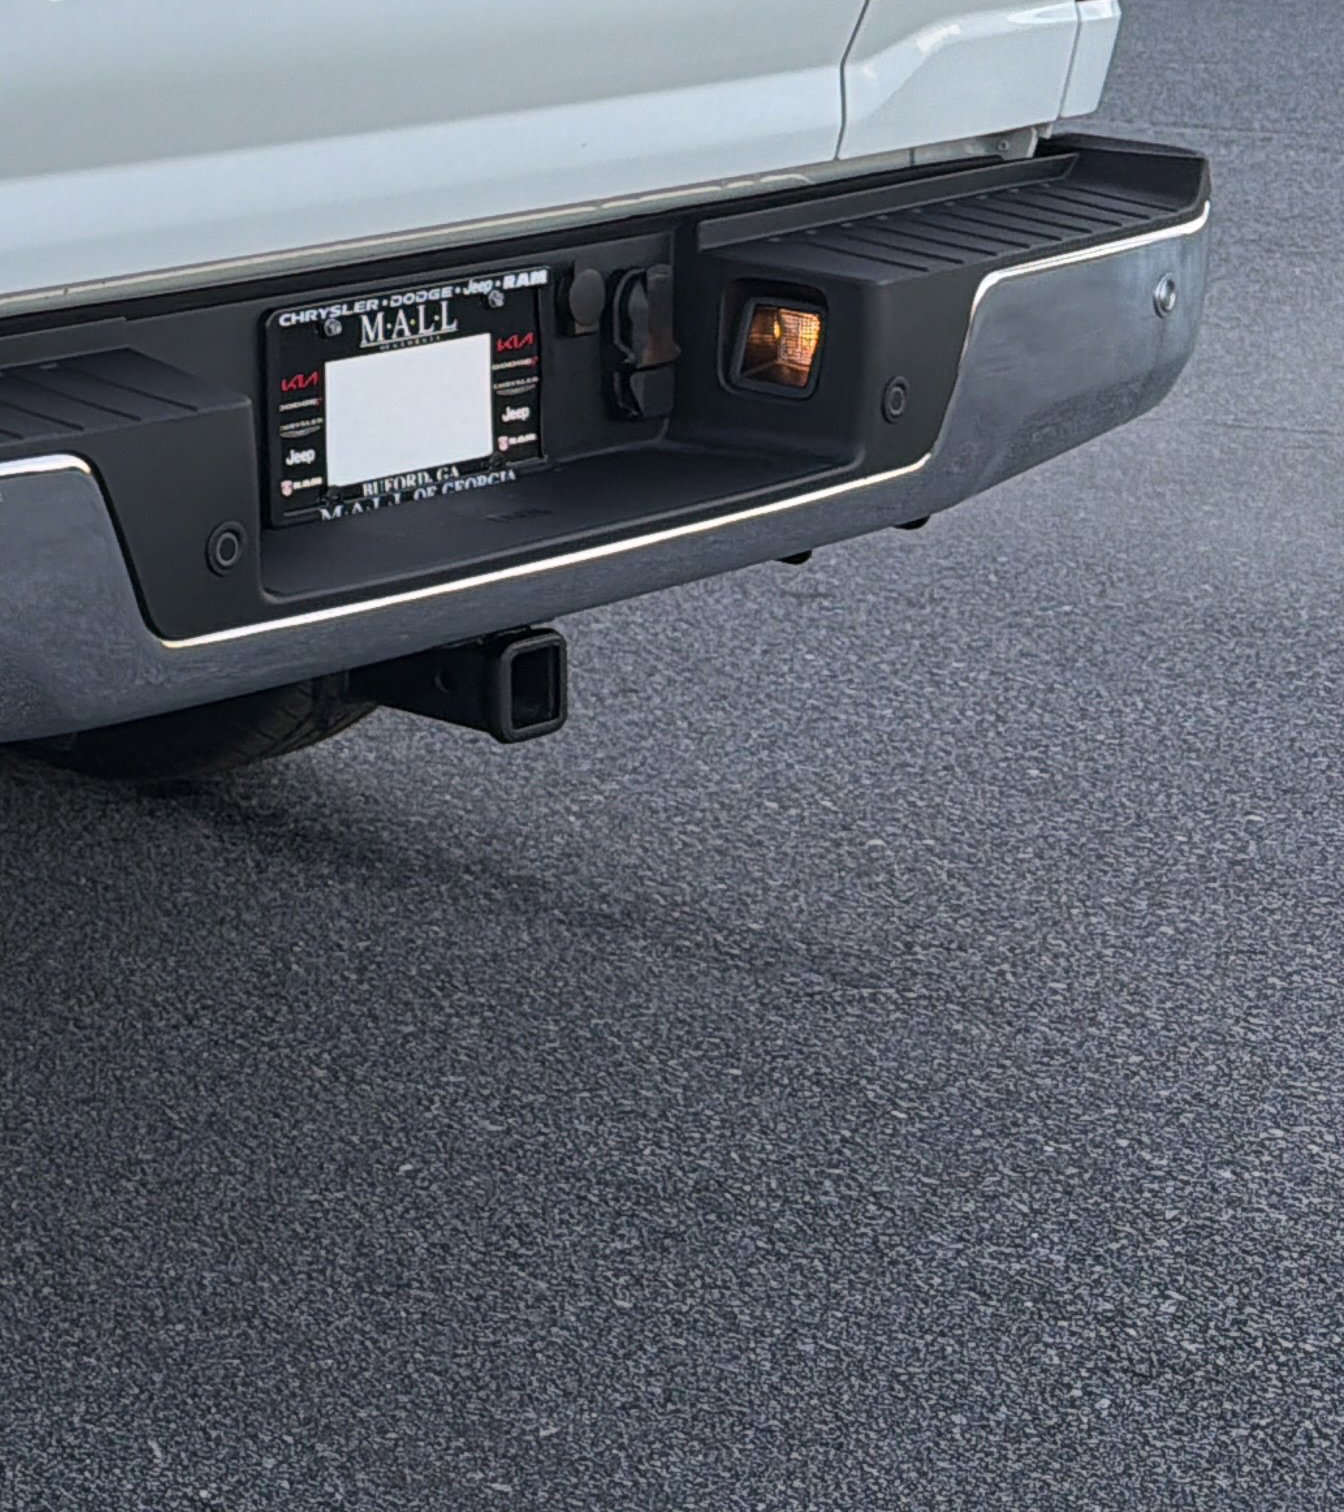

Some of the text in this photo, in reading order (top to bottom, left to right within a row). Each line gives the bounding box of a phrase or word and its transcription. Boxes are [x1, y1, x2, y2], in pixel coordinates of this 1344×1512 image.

[278, 269, 549, 327] CHRYSLER DODGE Jeep RAM
[502, 406, 530, 422] Jeep
[285, 448, 316, 466] Jeep
[437, 464, 461, 481] GA
